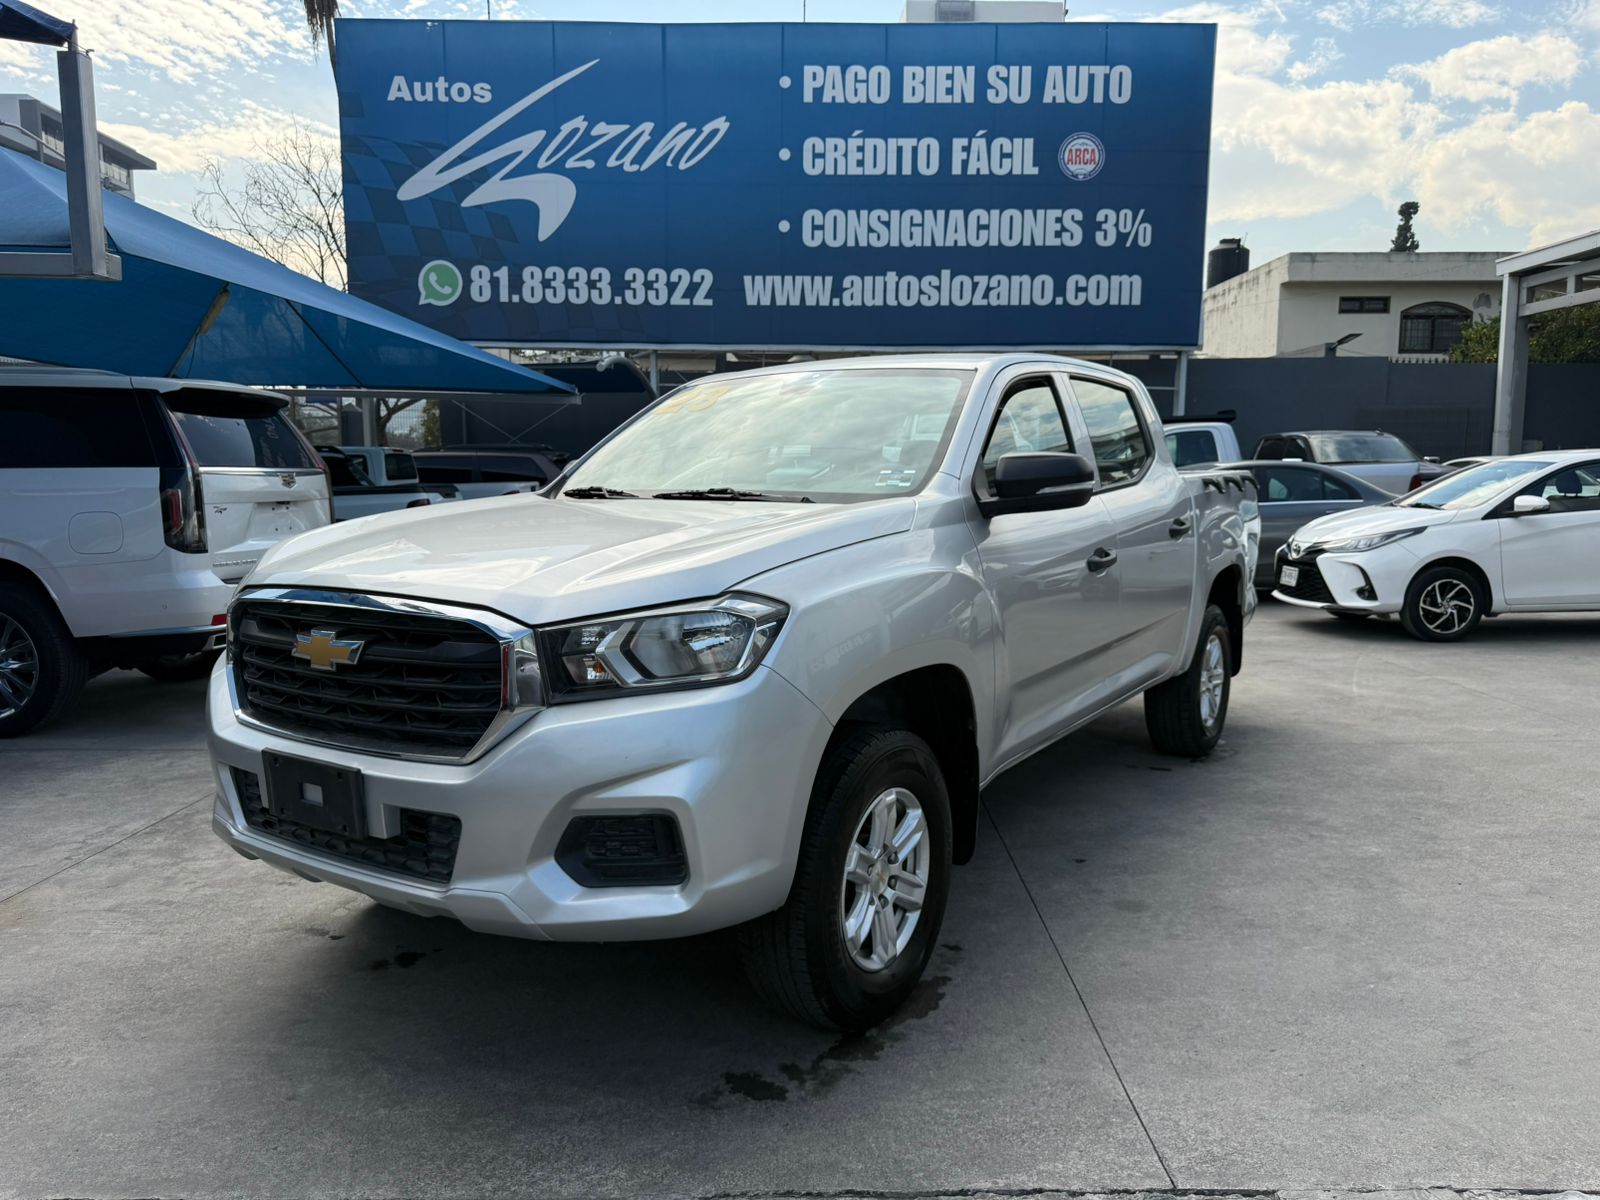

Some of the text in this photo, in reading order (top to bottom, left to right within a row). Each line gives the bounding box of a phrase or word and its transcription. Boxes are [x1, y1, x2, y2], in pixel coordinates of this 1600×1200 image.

[386, 75, 491, 103] Autos
[803, 65, 1133, 105] PAGO BIEN SU AUTO
[397, 58, 730, 242] Lozano
[803, 131, 1039, 176] CRÉDITO FÁCIL
[1067, 147, 1096, 165] ARCA
[802, 208, 1153, 248] CONSIGNACIONES 3%
[469, 265, 714, 306] 81.8333.3322
[743, 269, 1143, 307] www.autoslozano.com
